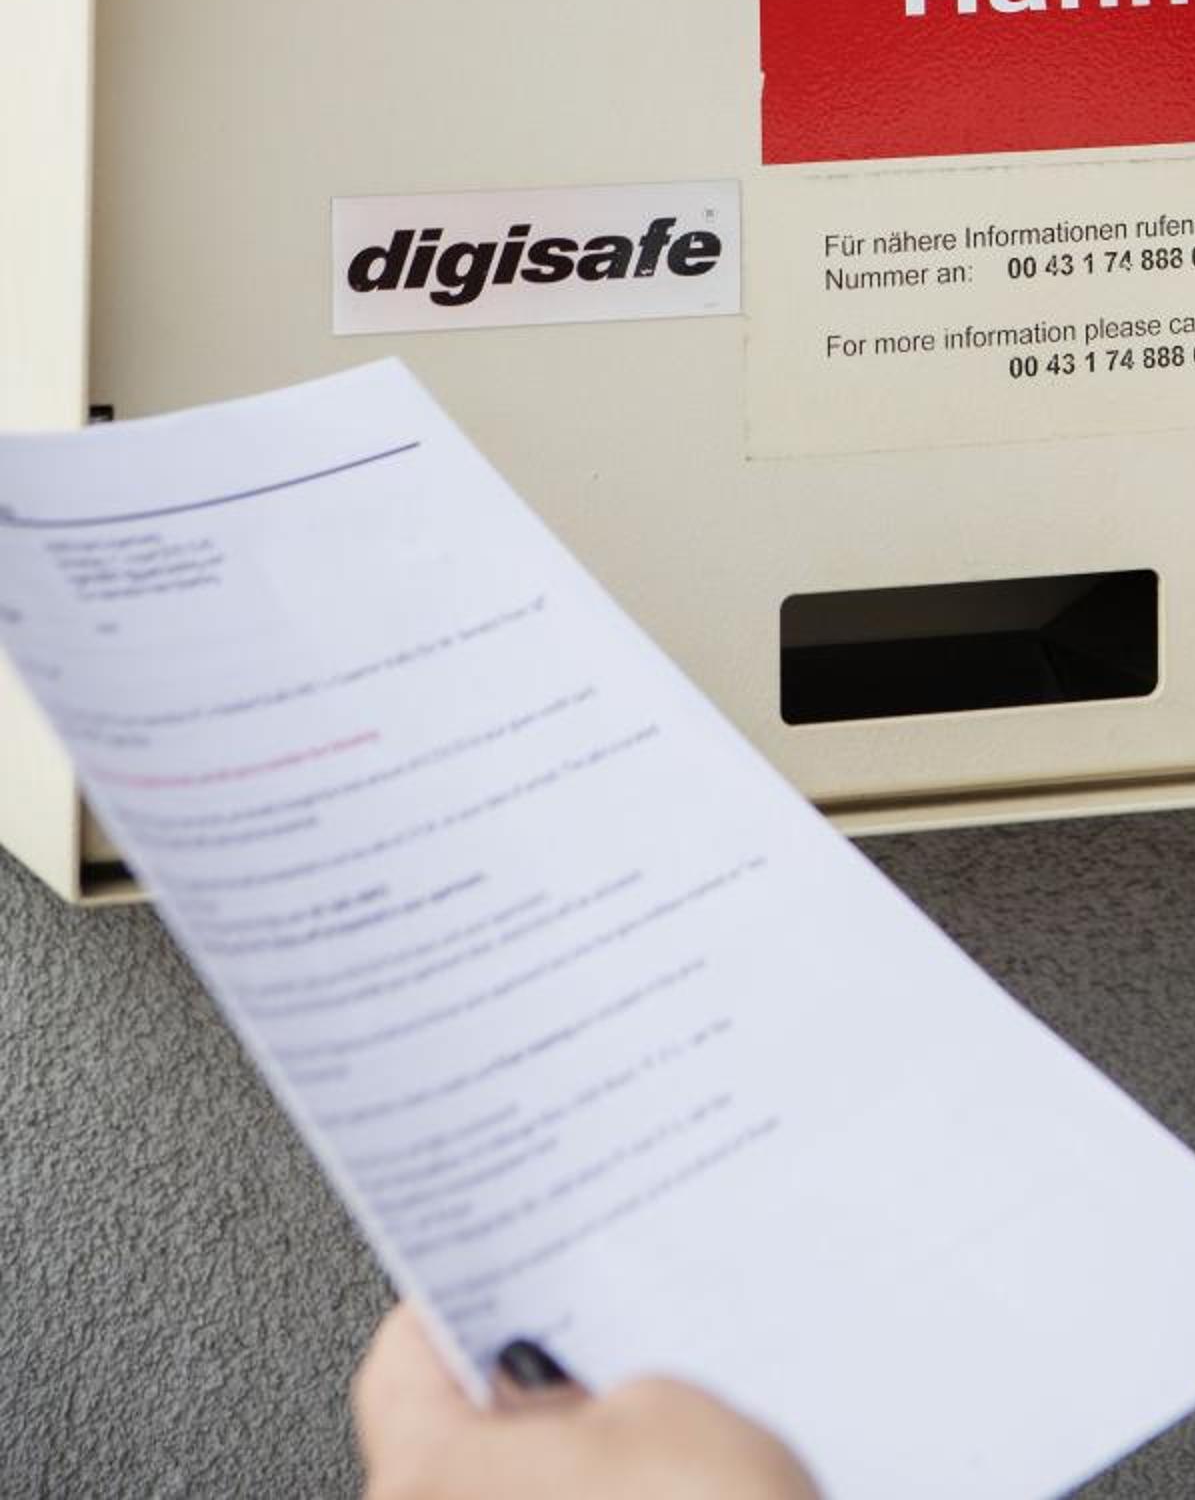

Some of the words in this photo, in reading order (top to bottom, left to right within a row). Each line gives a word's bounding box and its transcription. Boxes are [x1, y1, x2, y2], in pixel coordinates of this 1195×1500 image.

[824, 234, 867, 258] Für
[872, 230, 957, 255] nähere
[965, 220, 1128, 249] Informationen
[1135, 213, 1195, 239] rufen
[347, 217, 722, 307] digisafe
[825, 266, 930, 291] Nummer
[936, 264, 974, 285] an:
[1008, 256, 1037, 280] 00
[1045, 254, 1075, 277] 43
[1082, 251, 1094, 275] 1
[1104, 250, 1134, 273] 74
[1141, 246, 1184, 271] 888
[826, 334, 868, 359] For
[874, 334, 936, 355] more
[944, 320, 1077, 350] information
[1084, 316, 1162, 346] please
[1009, 356, 1039, 380] 00
[1046, 352, 1076, 376] 43
[1084, 351, 1096, 374] 1
[1105, 348, 1136, 373] 74
[1142, 345, 1186, 370] 888
